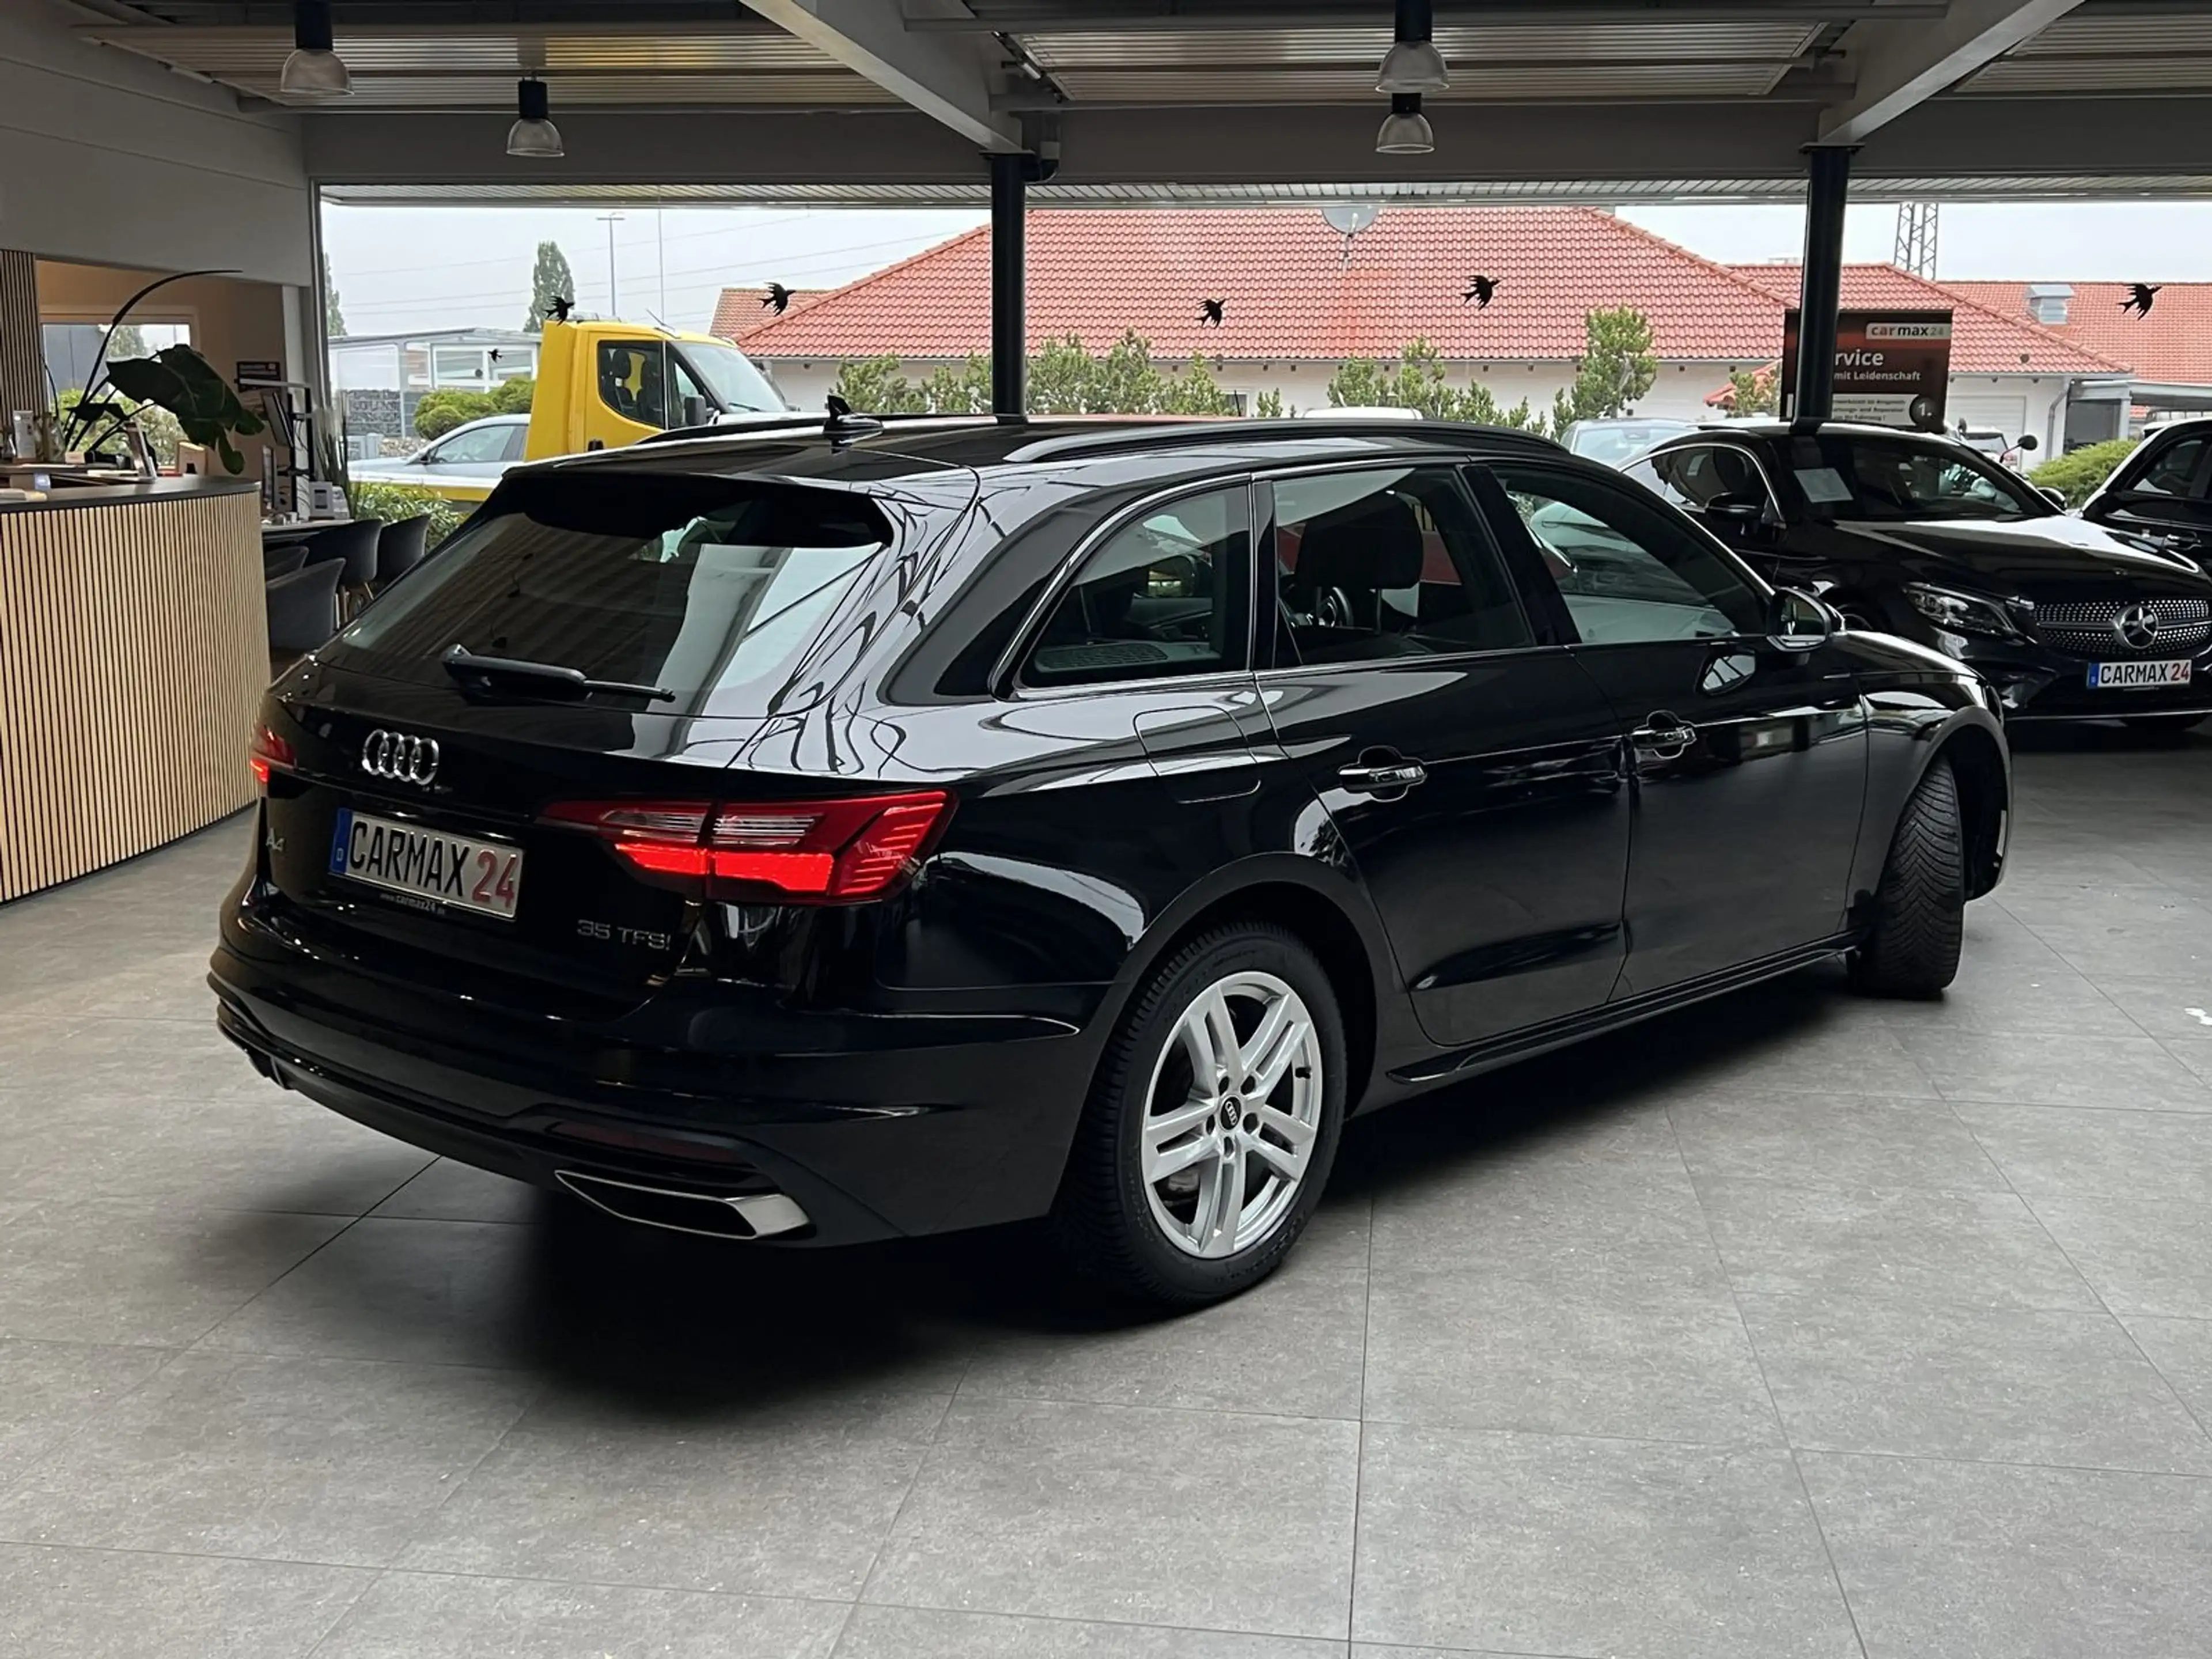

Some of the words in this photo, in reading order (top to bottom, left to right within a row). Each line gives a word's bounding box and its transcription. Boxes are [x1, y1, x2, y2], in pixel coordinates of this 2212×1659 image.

[1872, 325, 1944, 336] carmax24
[1834, 349, 1884, 366] rvice
[1834, 372, 1851, 381] mit
[1854, 371, 1922, 381] Leidenschaft
[1918, 402, 1932, 417] 1.
[2101, 664, 2168, 684] CARMAX
[2171, 662, 2189, 681] 24
[266, 827, 285, 853] A4
[349, 820, 470, 896] CARMAX
[471, 849, 517, 909] 24
[577, 919, 611, 940] 35
[616, 926, 671, 952] TFSI
